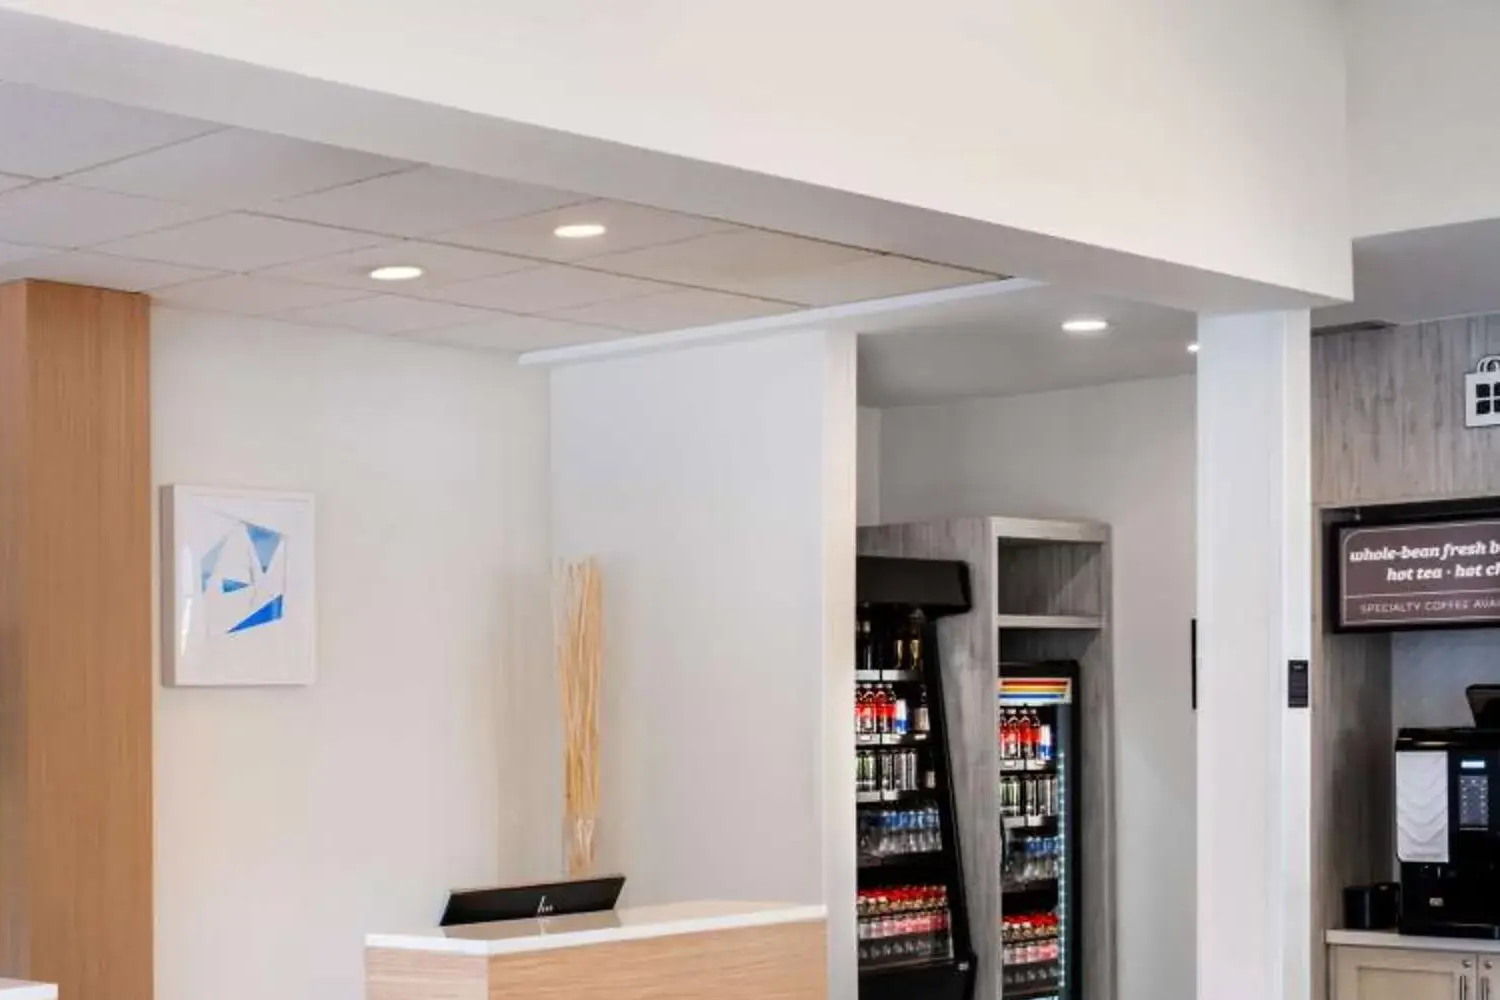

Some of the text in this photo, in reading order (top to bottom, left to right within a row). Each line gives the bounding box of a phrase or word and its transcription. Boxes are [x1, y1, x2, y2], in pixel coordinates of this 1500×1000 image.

[1349, 545, 1440, 562] whole-bean
[1439, 540, 1487, 561] fresh
[1386, 567, 1414, 582] hot
[1416, 566, 1443, 580] tea
[1454, 563, 1484, 578] hot
[1360, 601, 1422, 614] SPECIALTY
[1424, 599, 1469, 612] COFFEE
